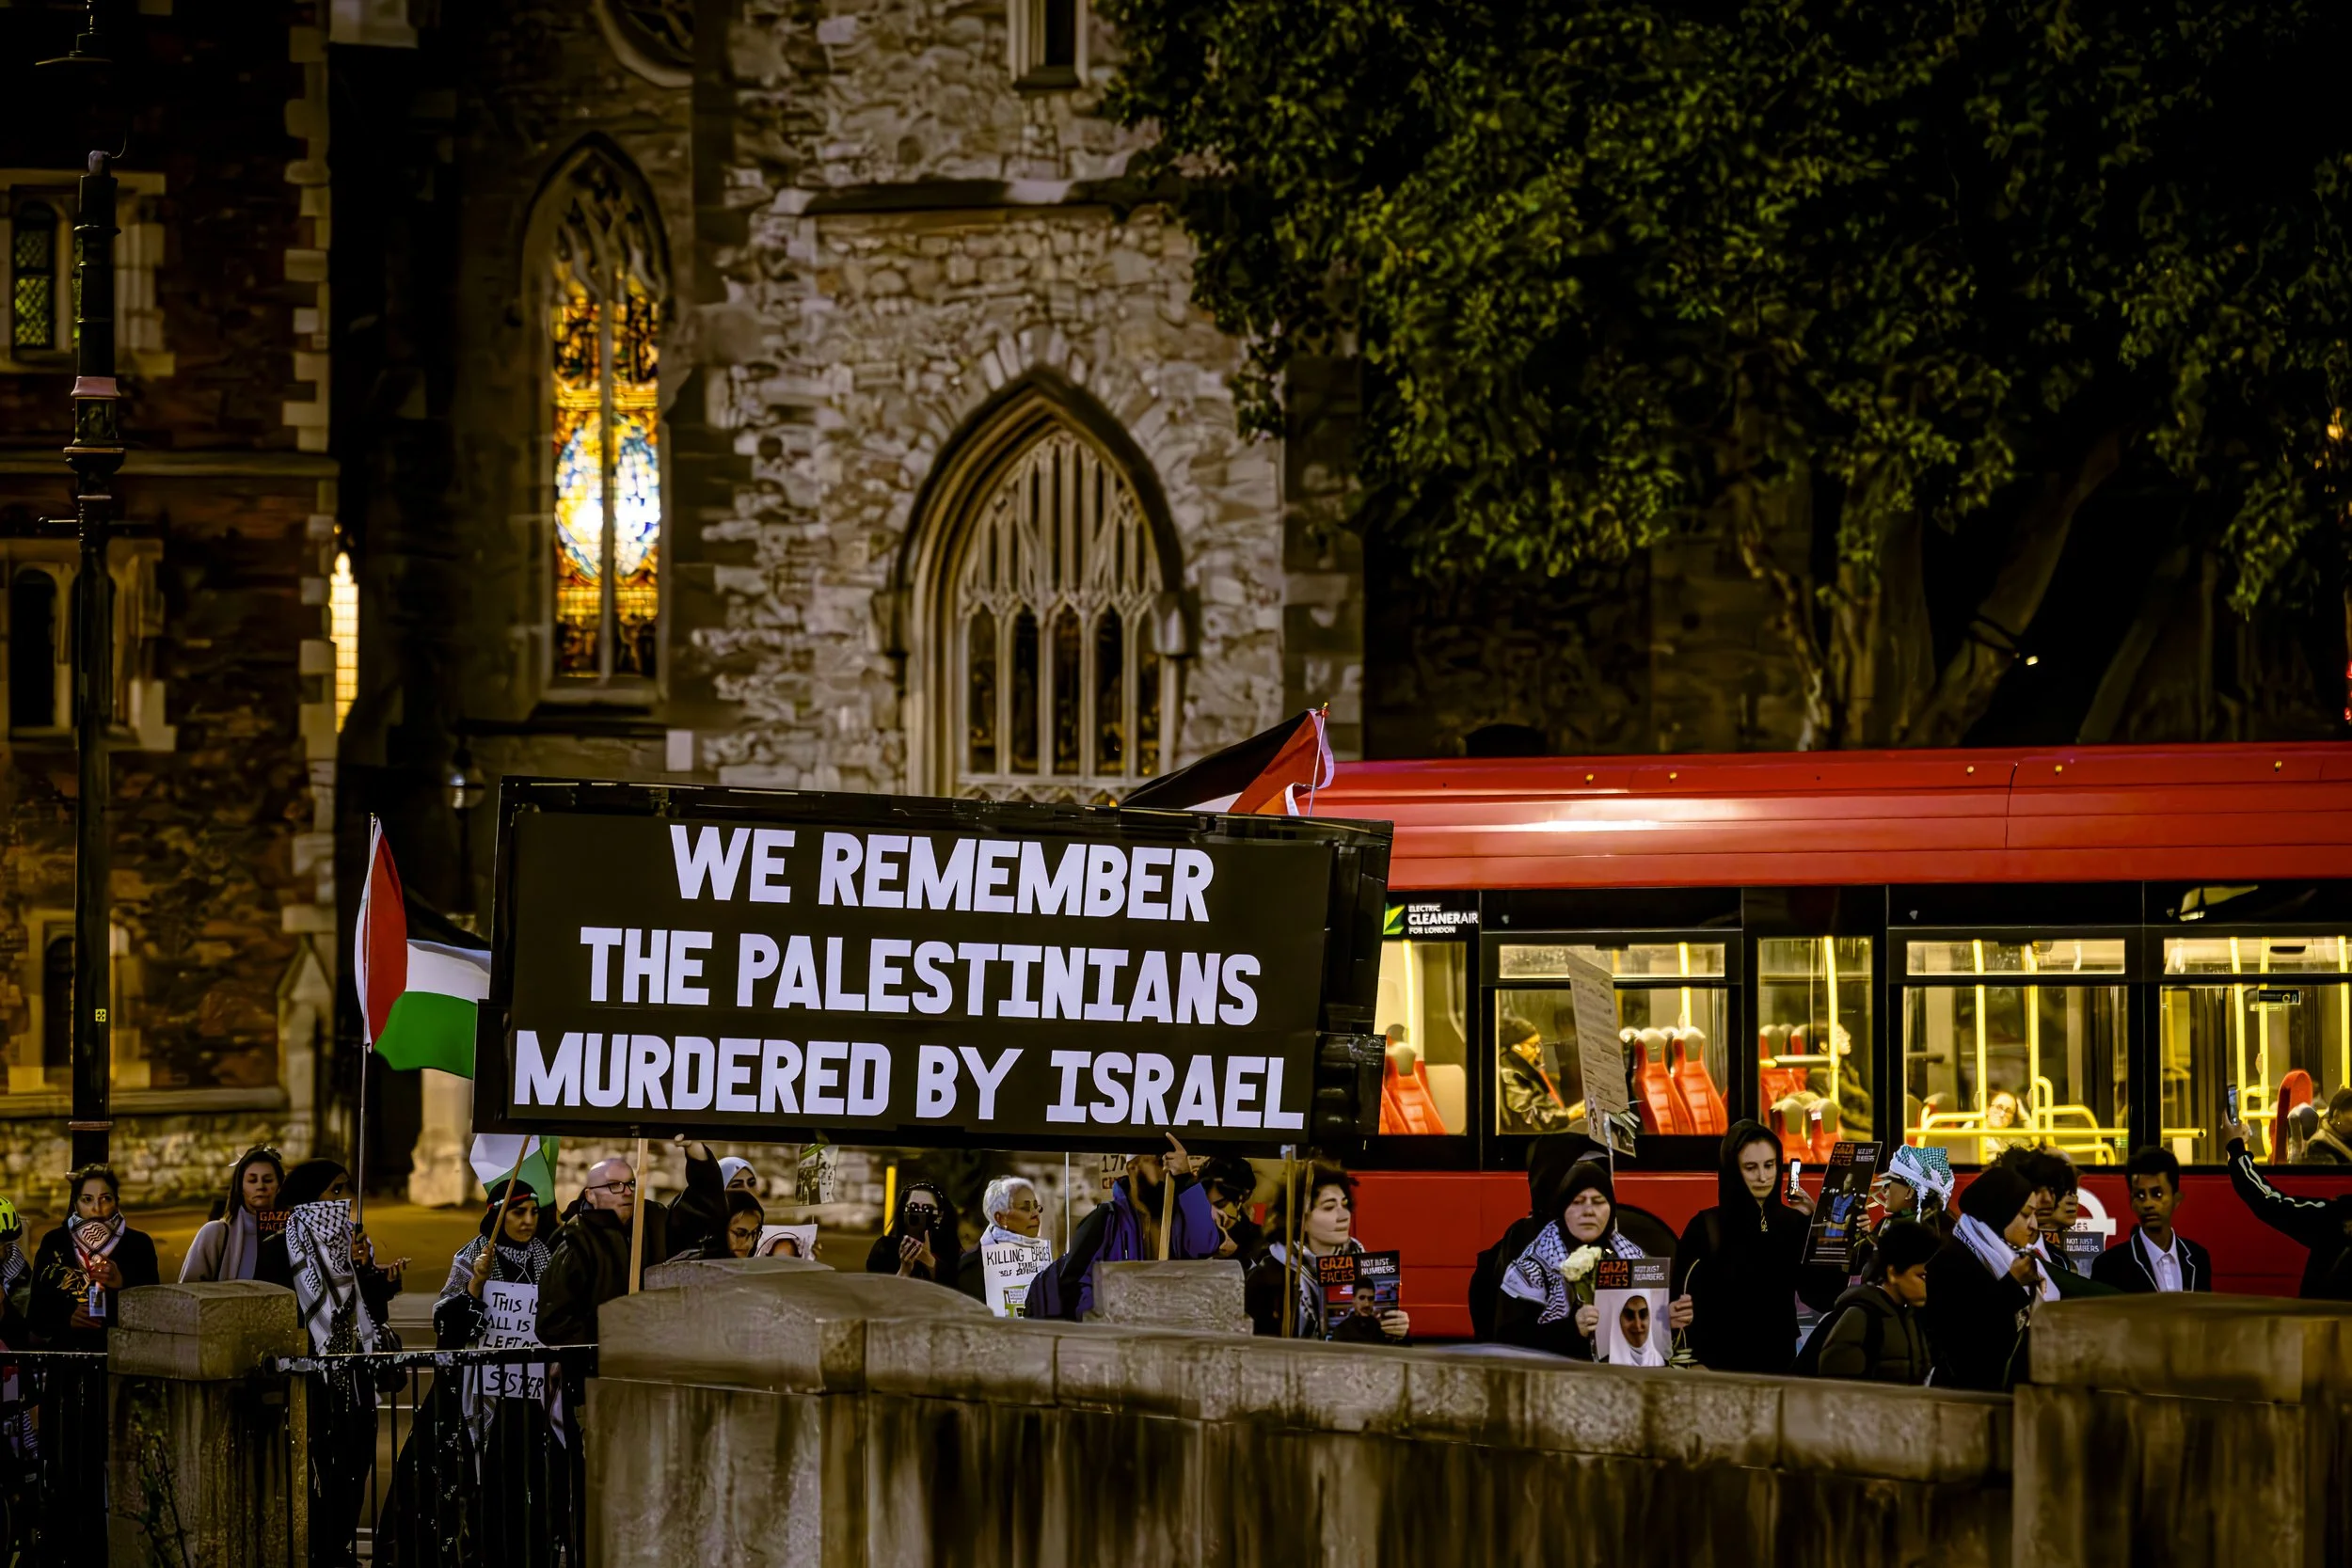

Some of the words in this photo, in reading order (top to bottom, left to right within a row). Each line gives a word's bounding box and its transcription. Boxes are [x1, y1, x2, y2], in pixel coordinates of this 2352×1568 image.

[670, 825, 795, 903] WE
[818, 832, 1214, 922] REMEMBER
[1408, 904, 1440, 912] ELECTRIC
[1408, 926, 1422, 934] FOR
[1424, 926, 1455, 934] LONDON
[580, 927, 712, 1006] THE
[737, 934, 1260, 1025] PALESTINIANS
[515, 1030, 891, 1116] MURDERED
[916, 1045, 1024, 1119] BY
[1046, 1051, 1304, 1129] ISRAEL
[2044, 1231, 2060, 1244] ZA
[987, 1248, 1024, 1265] KILLING
[1319, 1256, 1354, 1270] GAZA
[1360, 1259, 1374, 1267] NOT
[1375, 1258, 1390, 1266] JUST
[1360, 1265, 1395, 1275] NUMBERS
[1600, 1261, 1629, 1274] GAZA
[1320, 1270, 1355, 1283] FACES
[492, 1292, 522, 1313] THIS
[516, 1319, 531, 1332] IS
[483, 1333, 522, 1349] LEFT
